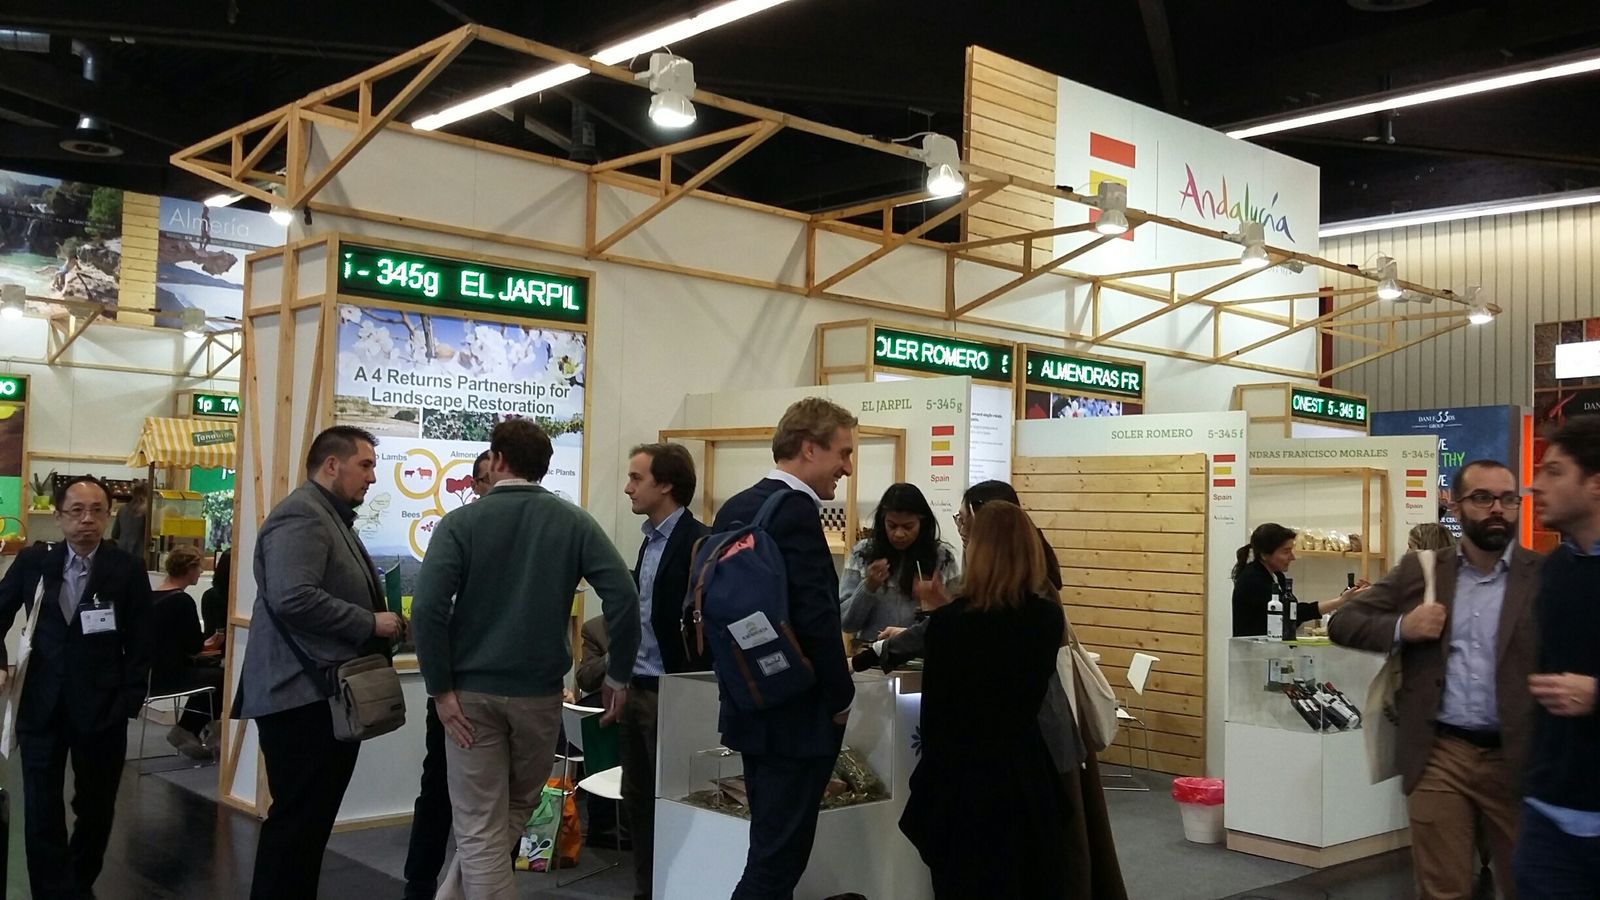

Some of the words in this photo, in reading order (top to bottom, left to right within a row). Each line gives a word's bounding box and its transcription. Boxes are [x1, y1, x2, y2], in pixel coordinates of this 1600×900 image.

[1179, 163, 1296, 244] Andalucía
[168, 207, 250, 238] Almería
[376, 258, 440, 297] 345g
[460, 270, 495, 299] EL
[498, 276, 580, 311] JARPIL
[921, 342, 989, 371] ROMERO
[354, 366, 368, 383] A
[371, 367, 383, 383] 4
[387, 369, 453, 389] Returns
[457, 376, 546, 398] Partnership
[549, 383, 571, 399] for
[1041, 359, 1119, 388] ALMENDRAS
[1121, 371, 1140, 391] FR
[197, 396, 213, 413] 1p
[371, 387, 463, 409] Landscape
[467, 396, 555, 415] Restoration
[861, 401, 875, 412] EL
[876, 398, 913, 413] JARPIL
[1111, 429, 1144, 440] SOLER
[1146, 428, 1193, 439] ROMERO
[381, 454, 408, 462] Lambs
[1282, 450, 1338, 459] FRANCISCO
[1340, 449, 1389, 458] MORALES
[555, 468, 576, 477] Plants
[930, 474, 950, 483] Spain
[401, 511, 421, 520] Bees
